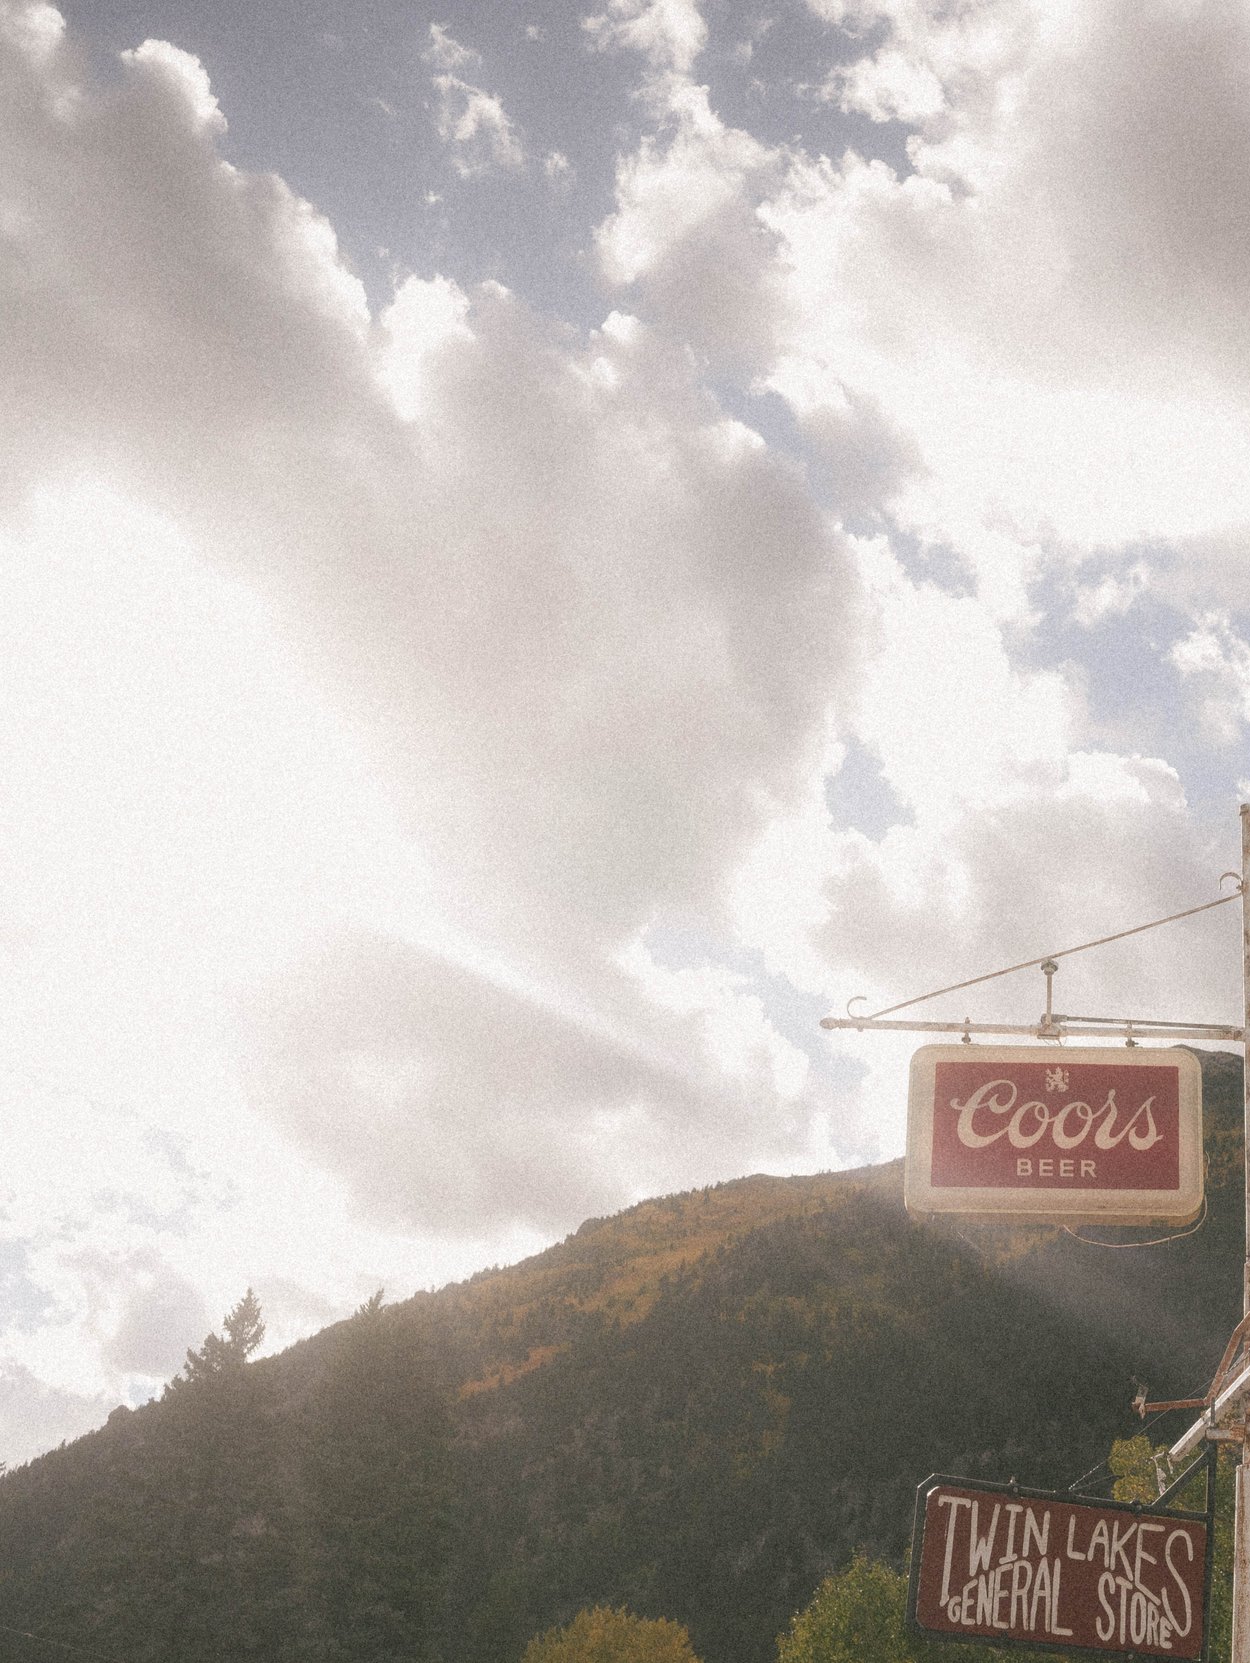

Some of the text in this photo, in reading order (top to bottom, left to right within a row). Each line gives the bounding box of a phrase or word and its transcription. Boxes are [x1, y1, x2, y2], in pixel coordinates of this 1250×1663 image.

[950, 1079, 1163, 1150] Coors
[1016, 1158, 1097, 1178] BEER
[938, 1494, 1194, 1637] TWIN LAKES
[947, 1556, 1173, 1649] GENERAL STORE
